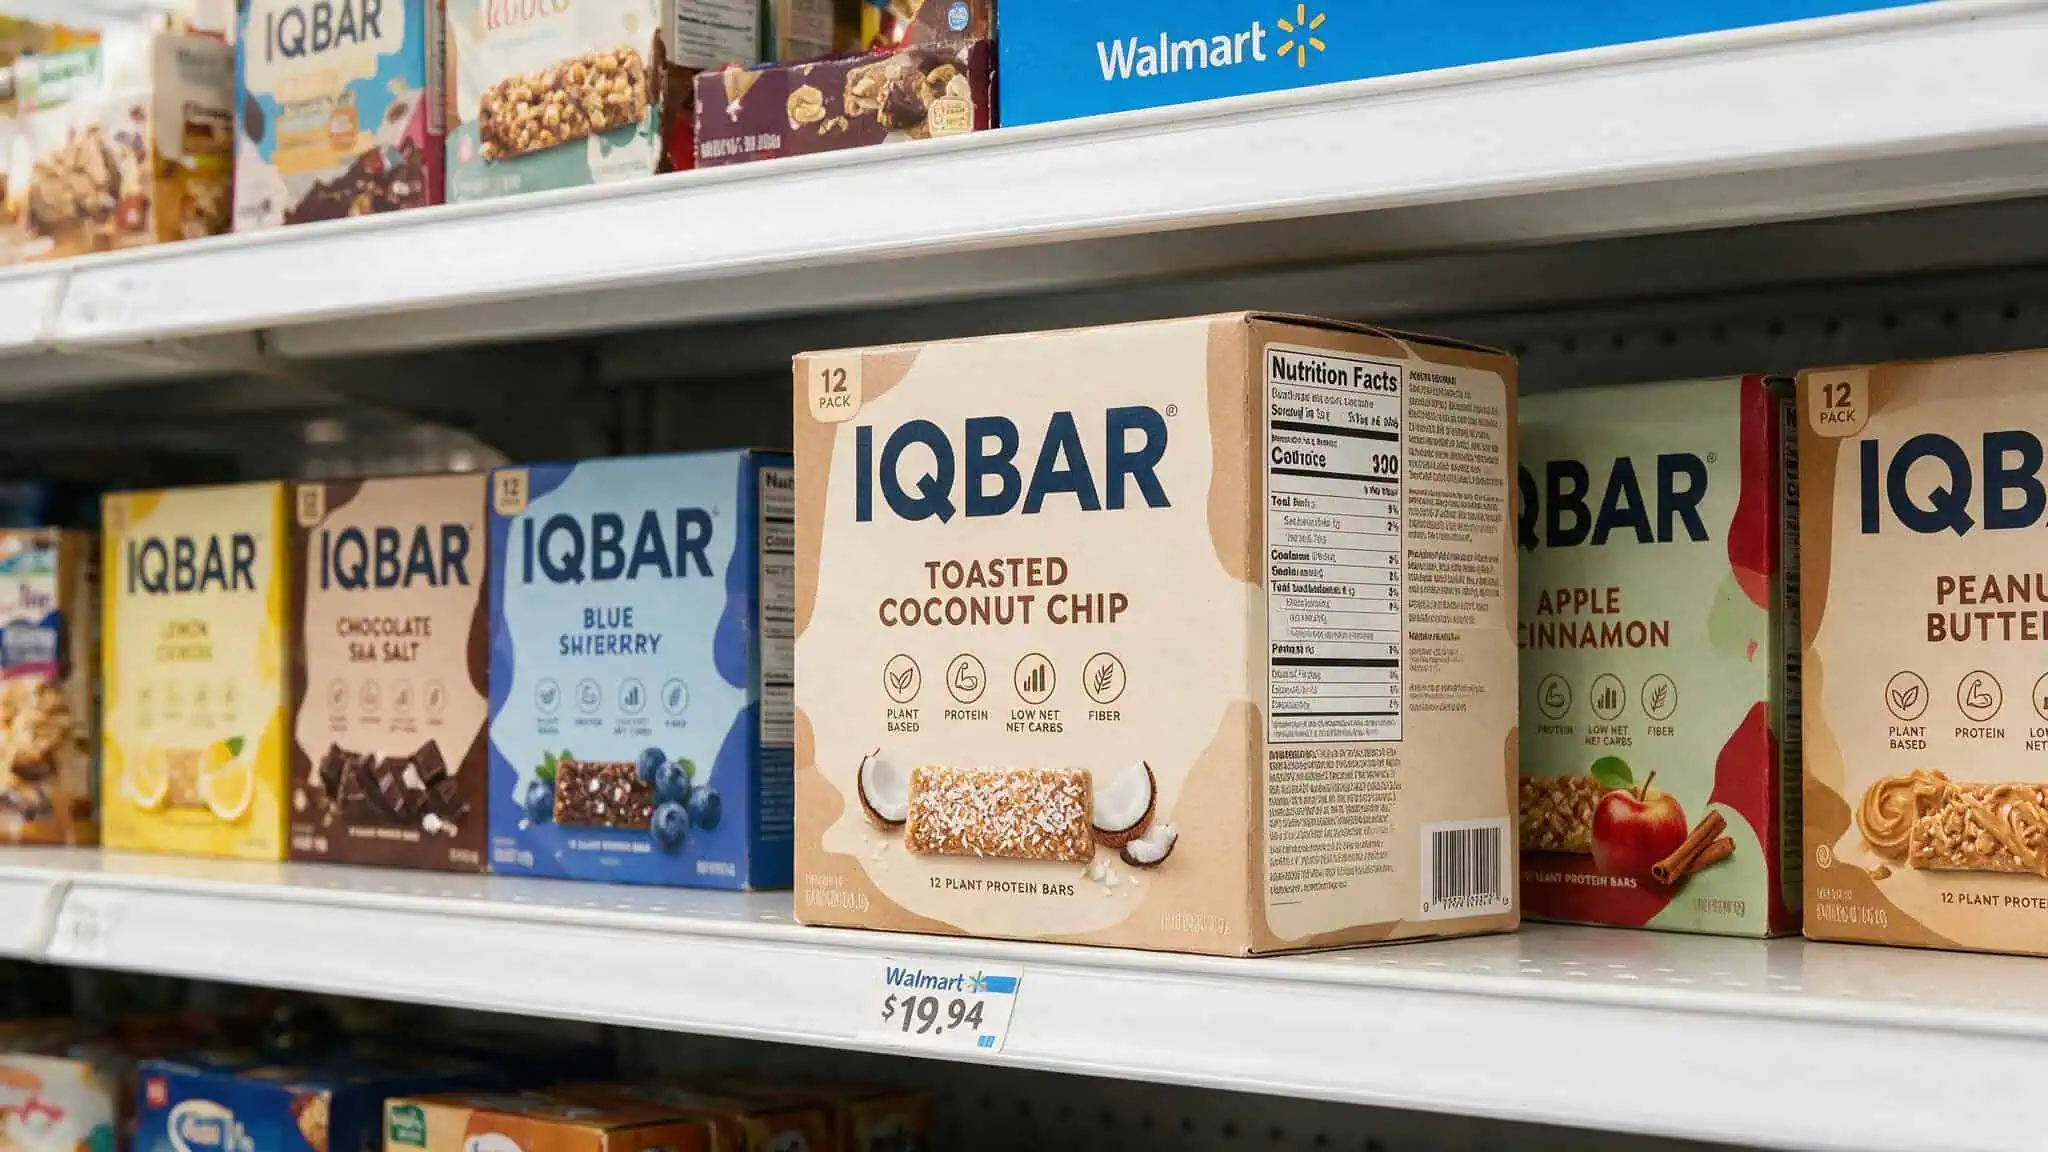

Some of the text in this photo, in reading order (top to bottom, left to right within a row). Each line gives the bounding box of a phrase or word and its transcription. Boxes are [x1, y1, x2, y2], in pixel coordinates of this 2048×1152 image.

[1096, 20, 1267, 81] Walmart
[820, 366, 848, 394] 12
[1271, 355, 1398, 393] Nutrition Facts
[819, 395, 851, 409] PACK
[1822, 382, 1852, 409] 12
[1820, 409, 1856, 425] PACK
[855, 405, 1172, 524] IQBAR
[1860, 430, 2048, 538] IQB
[321, 523, 471, 591] IQBAR
[522, 507, 714, 584] IQBAR
[127, 532, 257, 596] IQBAR
[924, 556, 1069, 590] TOASTED
[878, 592, 1130, 628] COCONUT CHIP
[1536, 586, 1621, 616] APPLE
[335, 615, 433, 638] CHOCOLATE
[584, 607, 633, 630] BLUE
[1927, 610, 2048, 643] BUTTE
[887, 709, 920, 720] PLANT
[944, 710, 989, 721] PROTEIN
[1011, 709, 1061, 721] LOW NET
[1088, 710, 1121, 721] FIBER
[887, 722, 920, 733] BASED
[1006, 722, 1064, 733] NET CARBS
[1647, 726, 1674, 737] FIBER
[1889, 726, 1927, 737] PLANT
[1955, 727, 2005, 739] PROTEIN
[1890, 739, 1927, 750] BASED
[2025, 740, 2048, 751] NET
[930, 877, 1075, 897] 12 PLANT PROTEIN BARS
[1941, 892, 1954, 904] 12
[1959, 894, 2000, 906] PLANT
[886, 966, 964, 992] Walmart
[881, 993, 985, 1035] $19.94
